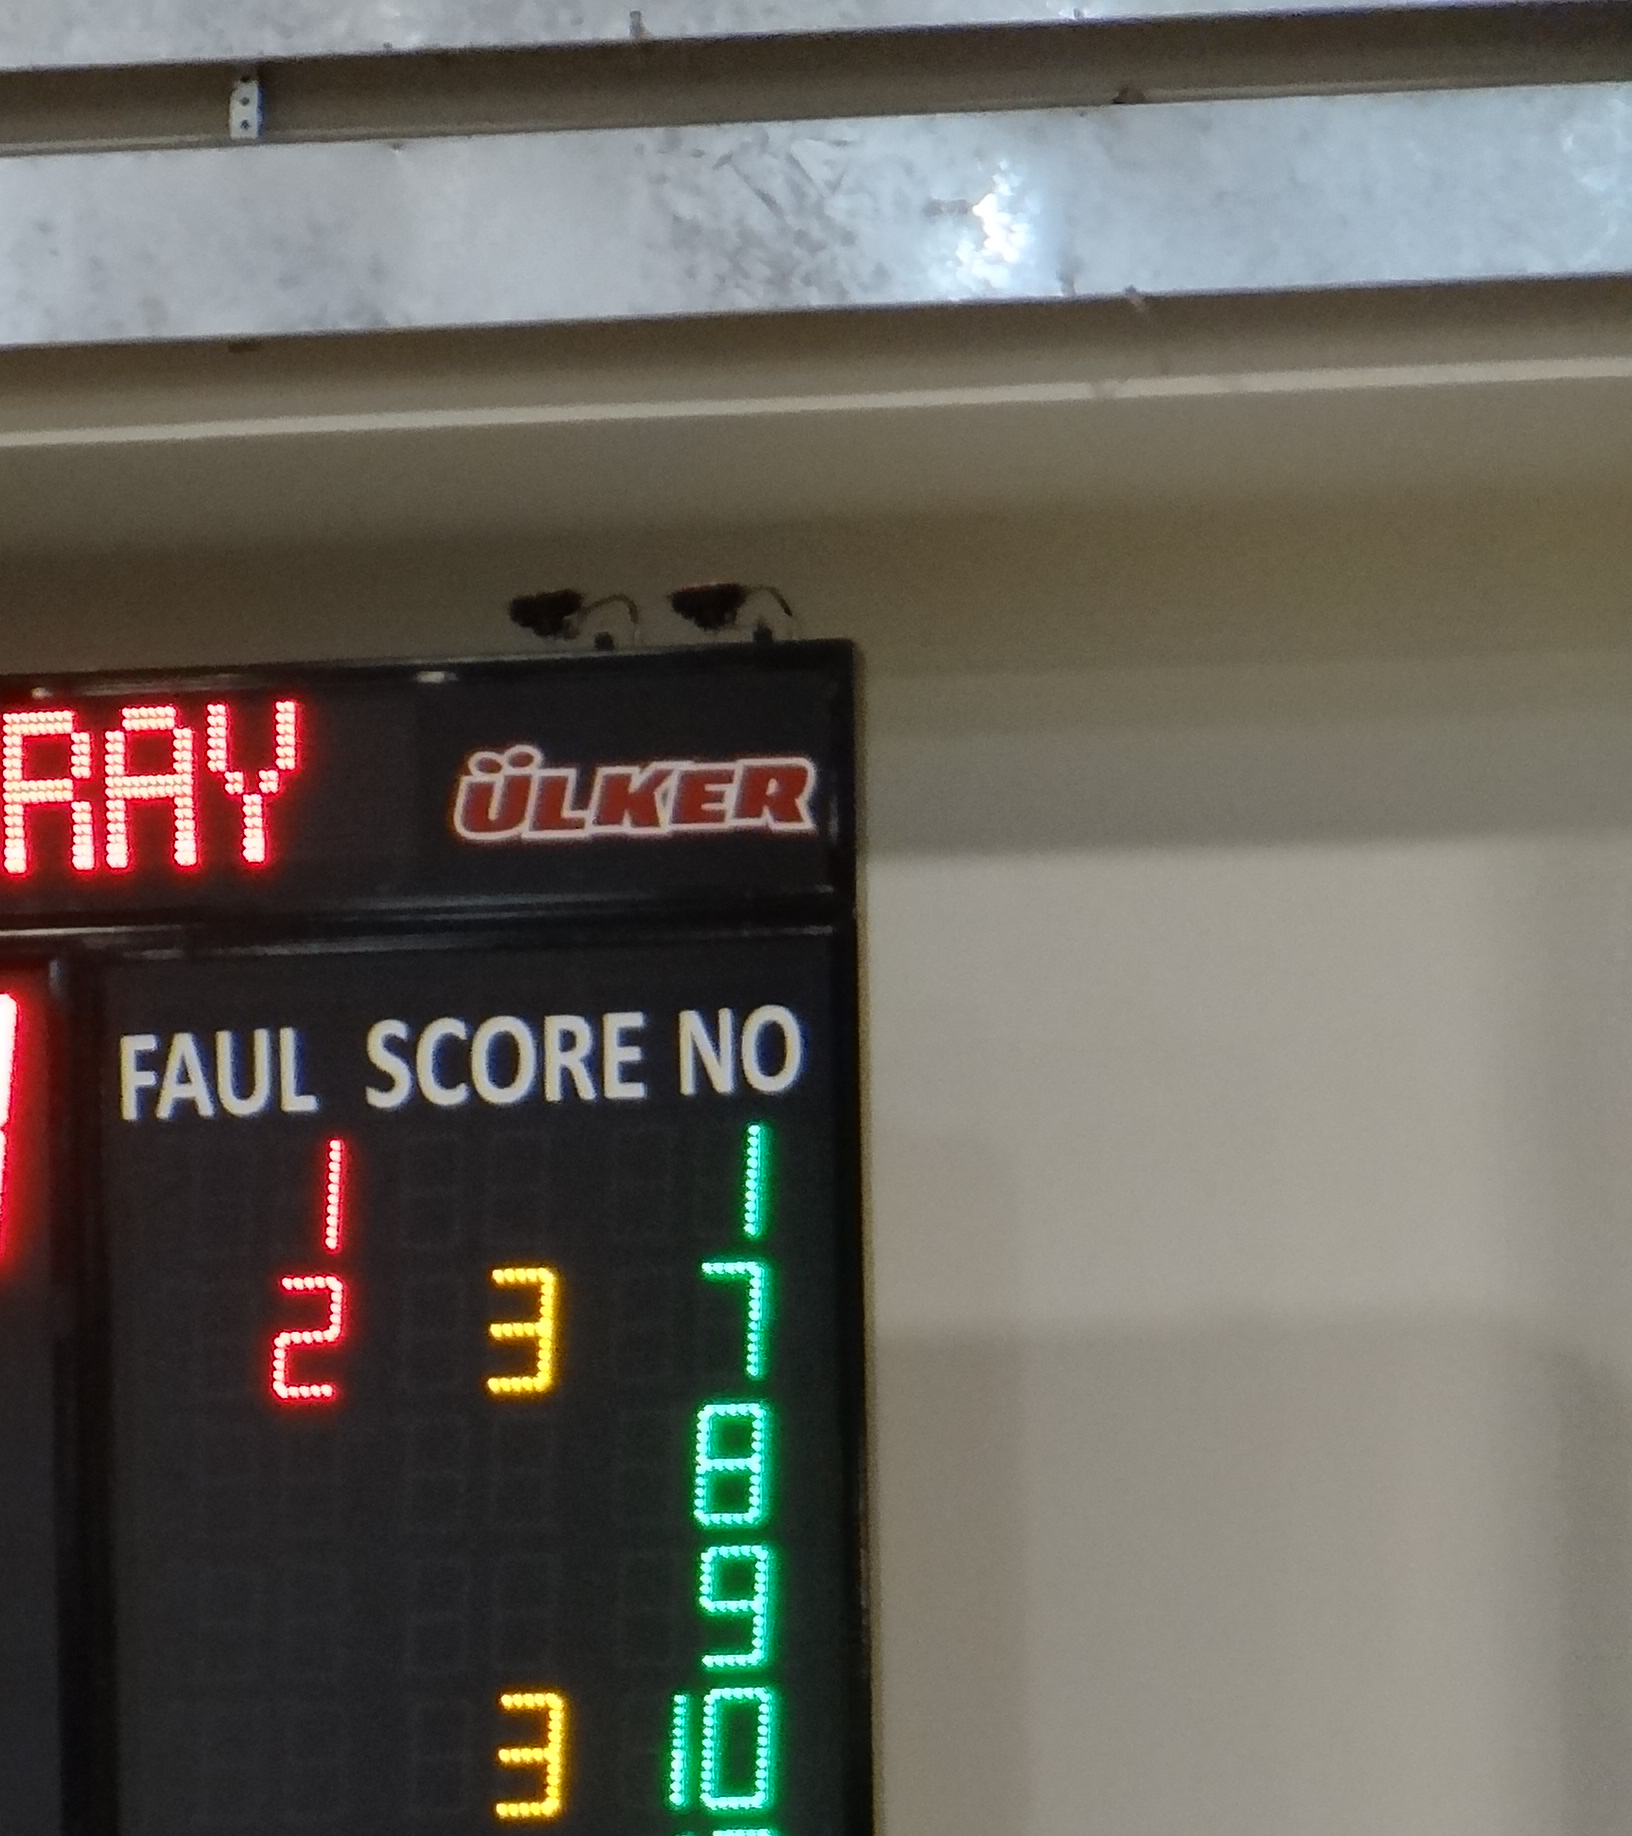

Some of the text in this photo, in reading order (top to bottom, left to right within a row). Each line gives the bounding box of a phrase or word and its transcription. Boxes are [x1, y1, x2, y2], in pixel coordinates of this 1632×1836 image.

[452, 743, 820, 842] ÜLKER
[118, 1004, 806, 1122] FAUL SCORE NO
[321, 1123, 766, 1256] 1 1
[268, 1259, 769, 1406] 2 3 7
[692, 1401, 770, 1528] 8
[697, 1543, 776, 1671] 9
[494, 1685, 777, 1820] 3 10
